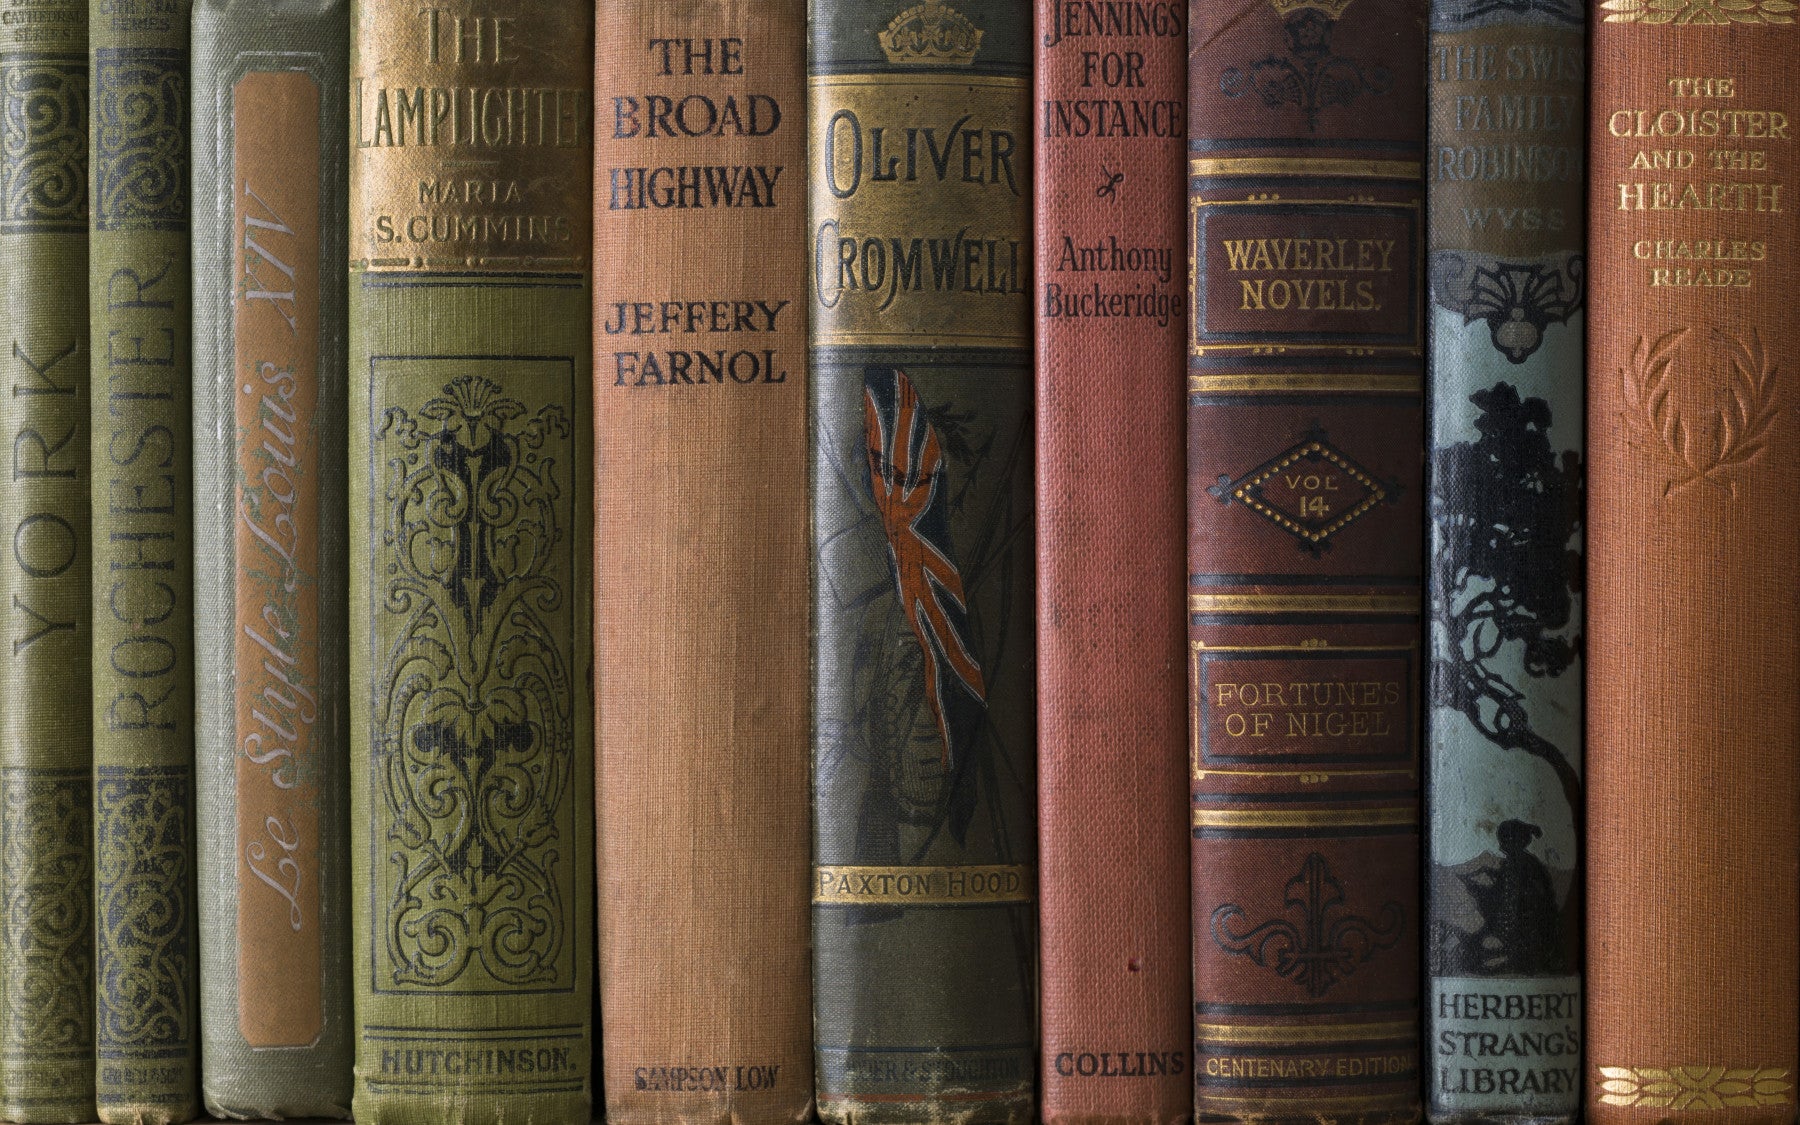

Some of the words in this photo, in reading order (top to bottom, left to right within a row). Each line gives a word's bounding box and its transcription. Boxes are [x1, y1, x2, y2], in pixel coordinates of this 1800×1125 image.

[418, 7, 520, 65] THE
[1043, 0, 1182, 48] JENNINGS
[650, 37, 744, 76] THE
[1080, 51, 1146, 88] FOR
[1436, 45, 1497, 82] THE
[1507, 45, 1584, 82] SWIS
[1668, 77, 1735, 98] THE
[612, 94, 782, 139] BROAD
[1043, 100, 1182, 138] INSTANCE
[1454, 95, 1577, 131] FAMILY
[1608, 110, 1791, 139] CLOISTER
[824, 108, 1020, 199] OLIVER
[1628, 149, 1694, 170] AND
[1708, 149, 1767, 171] THE
[418, 178, 522, 205] MARIA
[609, 165, 785, 210] HIGHWAY
[1617, 182, 1784, 213] HEARTH
[1461, 206, 1566, 231] WYSS
[244, 179, 298, 337] XIV
[815, 217, 1027, 312] CROMWELL
[1056, 235, 1174, 284] Anthony
[1222, 237, 1397, 272] WAVERLEY
[1632, 238, 1768, 261] CHARLES
[1238, 278, 1383, 311] NOVELS.
[1649, 266, 1751, 288] READE
[605, 299, 792, 336] JEFFERY
[1043, 282, 1182, 328] Buckeridge
[613, 349, 787, 387] FARNOL
[107, 252, 177, 733] ROCHESTER
[239, 361, 298, 593] Louis
[1285, 474, 1339, 491] VOL
[13, 338, 78, 657] YORK
[1299, 495, 1330, 519] 14
[244, 603, 317, 790] Style
[1214, 681, 1401, 708] FORTUNES
[1225, 712, 1273, 738] OF
[1285, 710, 1392, 738] NIGEL
[247, 813, 301, 931] Le
[818, 869, 931, 897] PAXTON
[948, 871, 1021, 898] HOOD
[1439, 992, 1578, 1021] HERBERT
[381, 1047, 577, 1075] HUTCHINSON.
[634, 1065, 730, 1092] SAMPSON
[735, 1064, 781, 1092] LOW
[1054, 1051, 1185, 1078] COLLINS
[1206, 1056, 1330, 1078] CENTENARY
[1336, 1055, 1412, 1077] EDITION
[1440, 1066, 1578, 1095] LIBRARY
